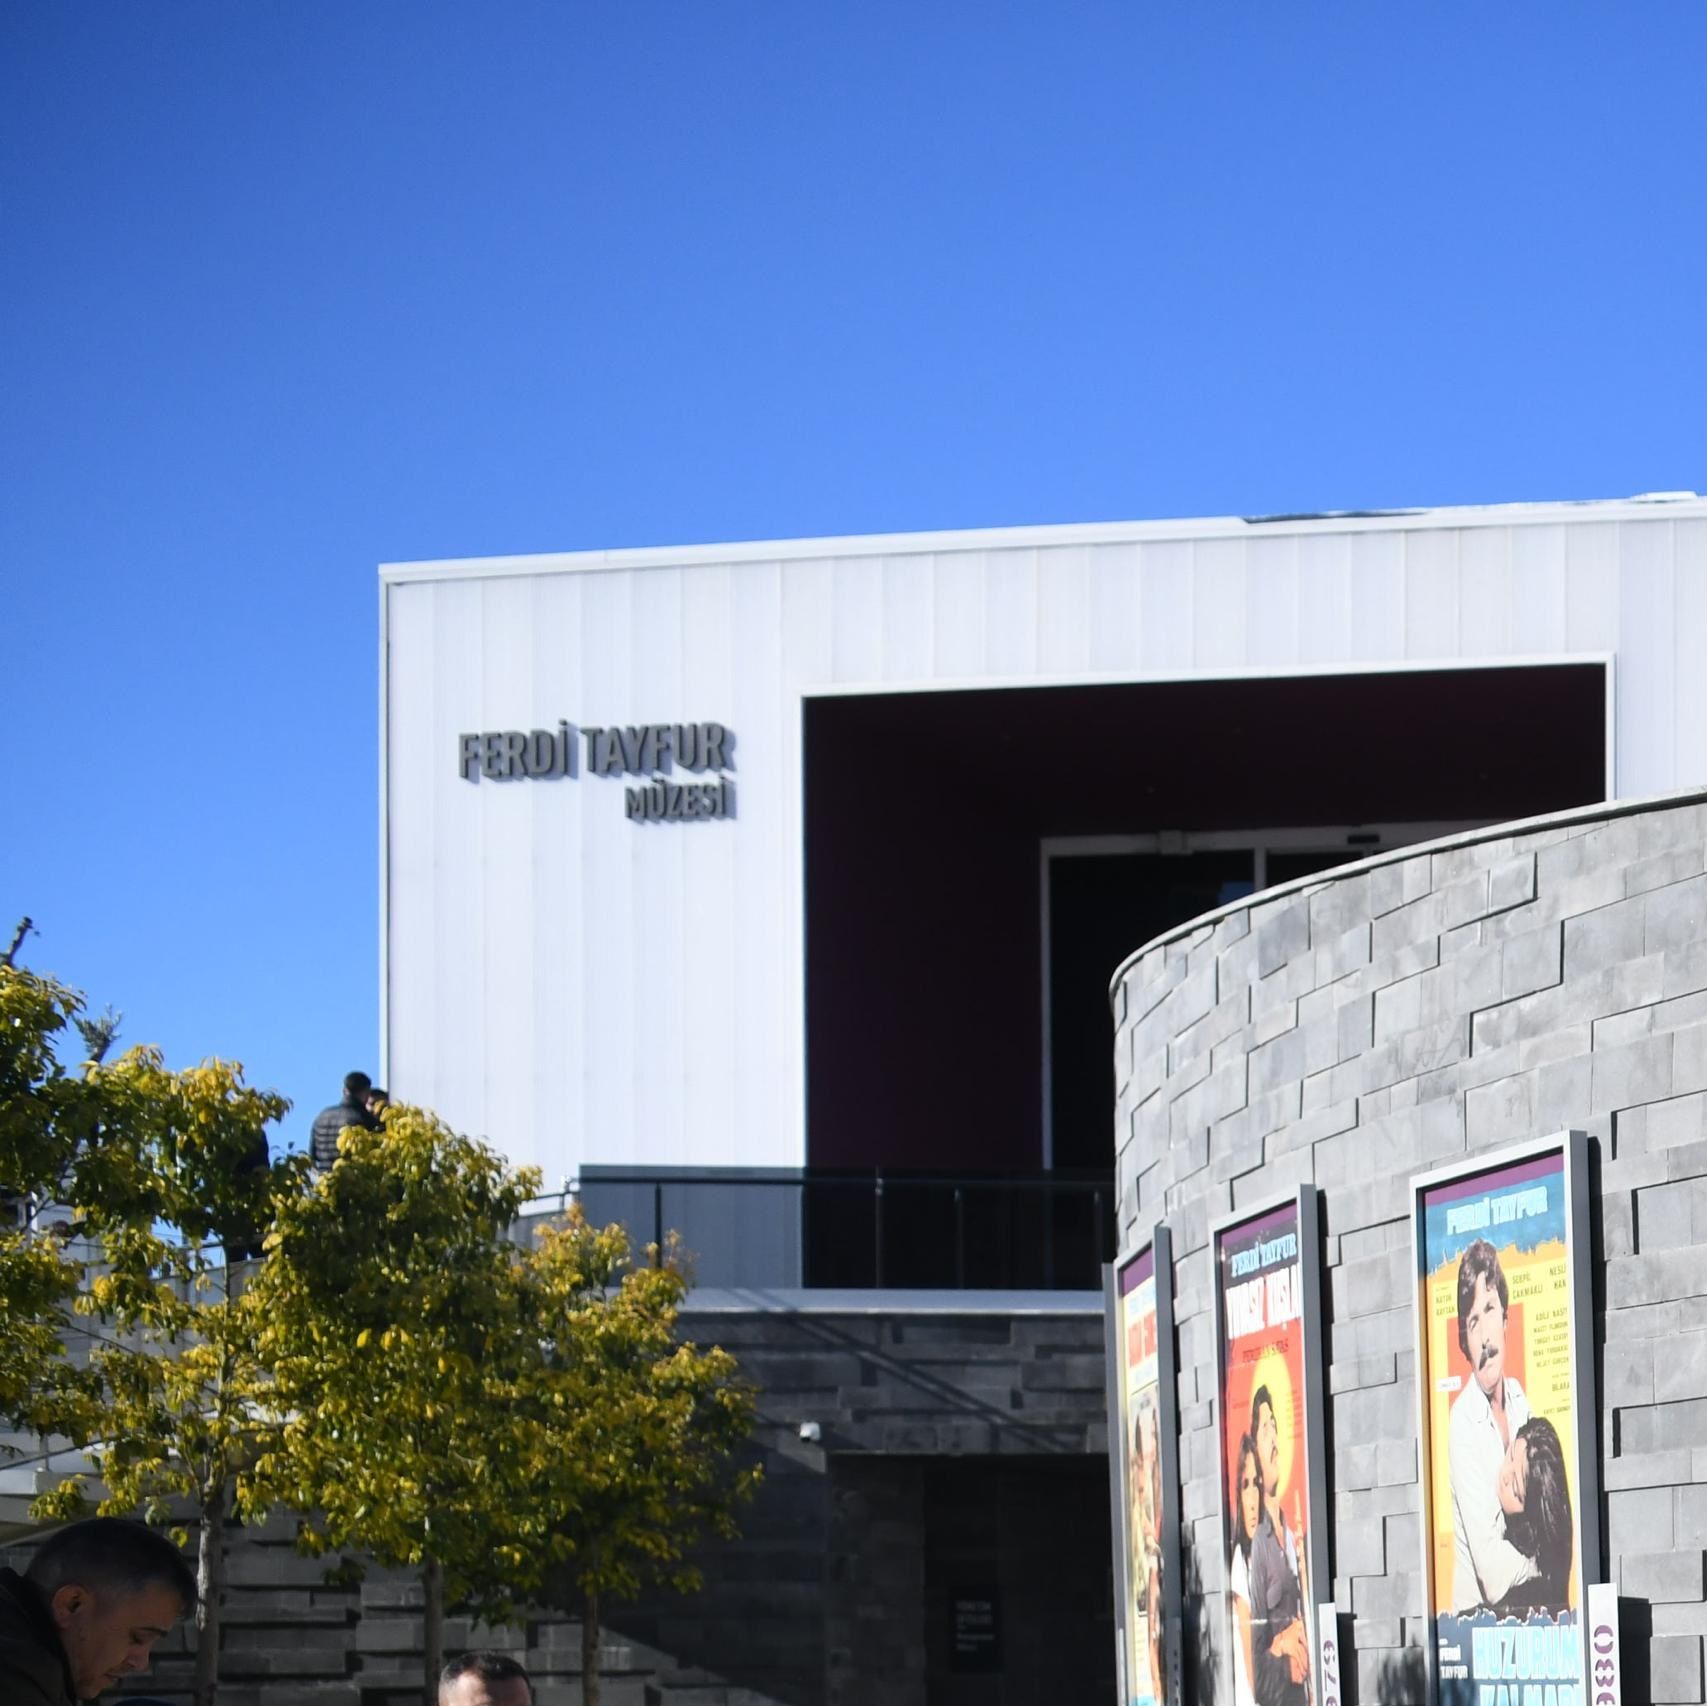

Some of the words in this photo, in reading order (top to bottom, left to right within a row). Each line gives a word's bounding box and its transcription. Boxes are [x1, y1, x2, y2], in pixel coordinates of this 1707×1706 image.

[459, 719, 571, 780] FERDİ
[581, 722, 729, 777] TAYFUR
[625, 774, 729, 822] MÜZESİ
[1447, 1197, 1490, 1235] FERDİ
[1491, 1186, 1548, 1224] TAYFUR
[1232, 1241, 1260, 1278] FERDİ
[1260, 1233, 1297, 1267] TAYFUR
[1440, 1665, 1468, 1680] TAYFUR
[1472, 1625, 1579, 1680] HUZURUM
